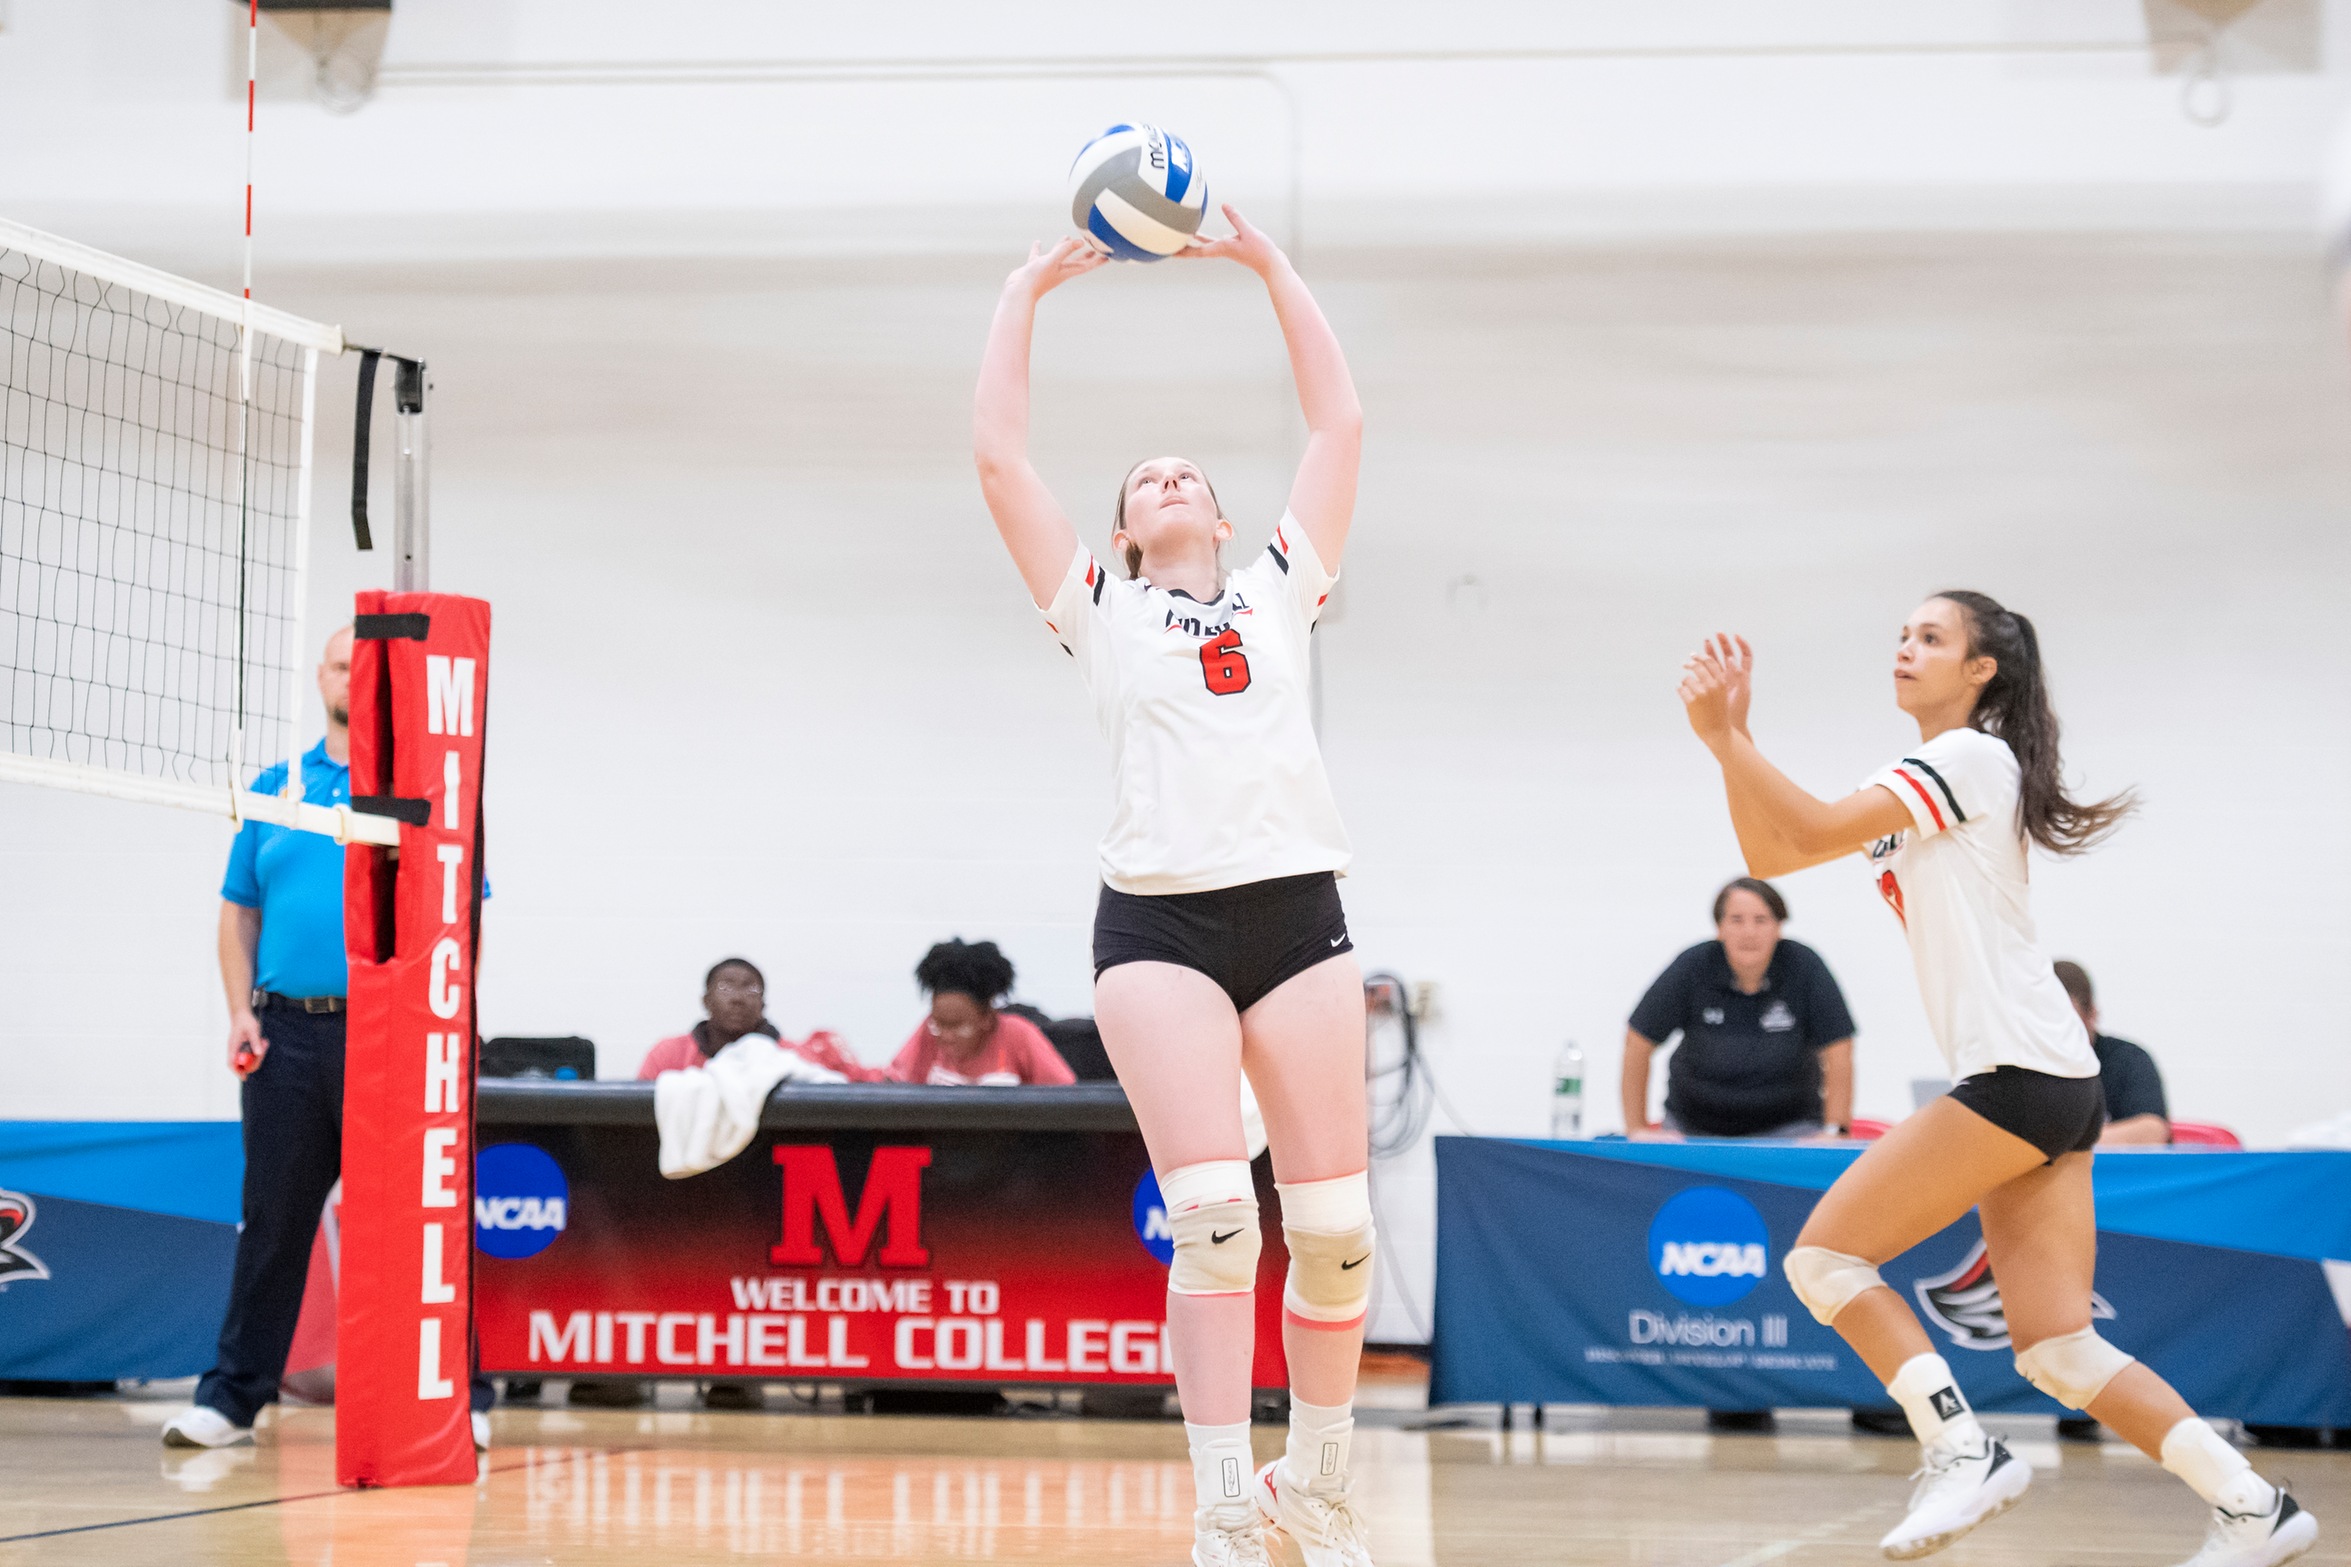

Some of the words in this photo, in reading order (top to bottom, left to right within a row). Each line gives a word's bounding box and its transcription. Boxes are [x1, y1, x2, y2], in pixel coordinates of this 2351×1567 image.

[1199, 629, 1251, 696] 6
[418, 655, 476, 1400] MITCHELL
[475, 1196, 567, 1231] NCAA
[771, 1145, 931, 1266] M
[1660, 1241, 1767, 1278] NCAA
[730, 1276, 931, 1313] WELCOME
[943, 1280, 999, 1315] TO
[528, 1310, 869, 1367] MITCHELL
[1628, 1309, 1756, 1347] Division
[1761, 1312, 1788, 1347] III
